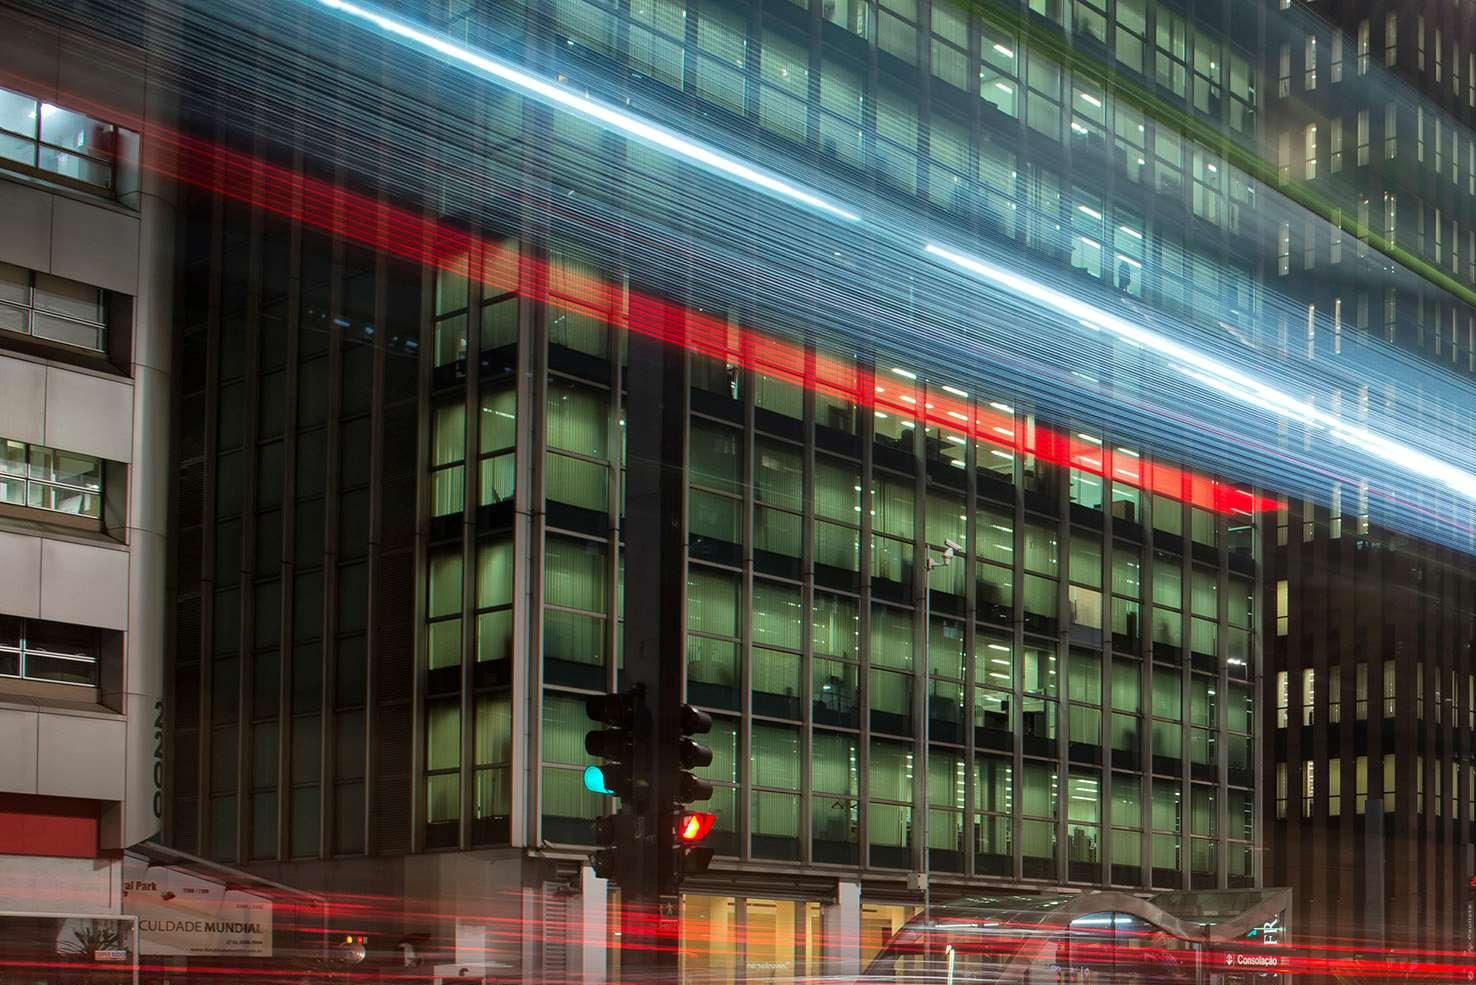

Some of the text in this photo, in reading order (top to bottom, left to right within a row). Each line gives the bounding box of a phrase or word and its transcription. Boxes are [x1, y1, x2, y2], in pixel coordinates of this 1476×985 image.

[153, 701, 165, 818] 2200
[136, 881, 157, 891] Park
[205, 921, 262, 934] MUNDIAL
[1237, 954, 1278, 967] Consolação
